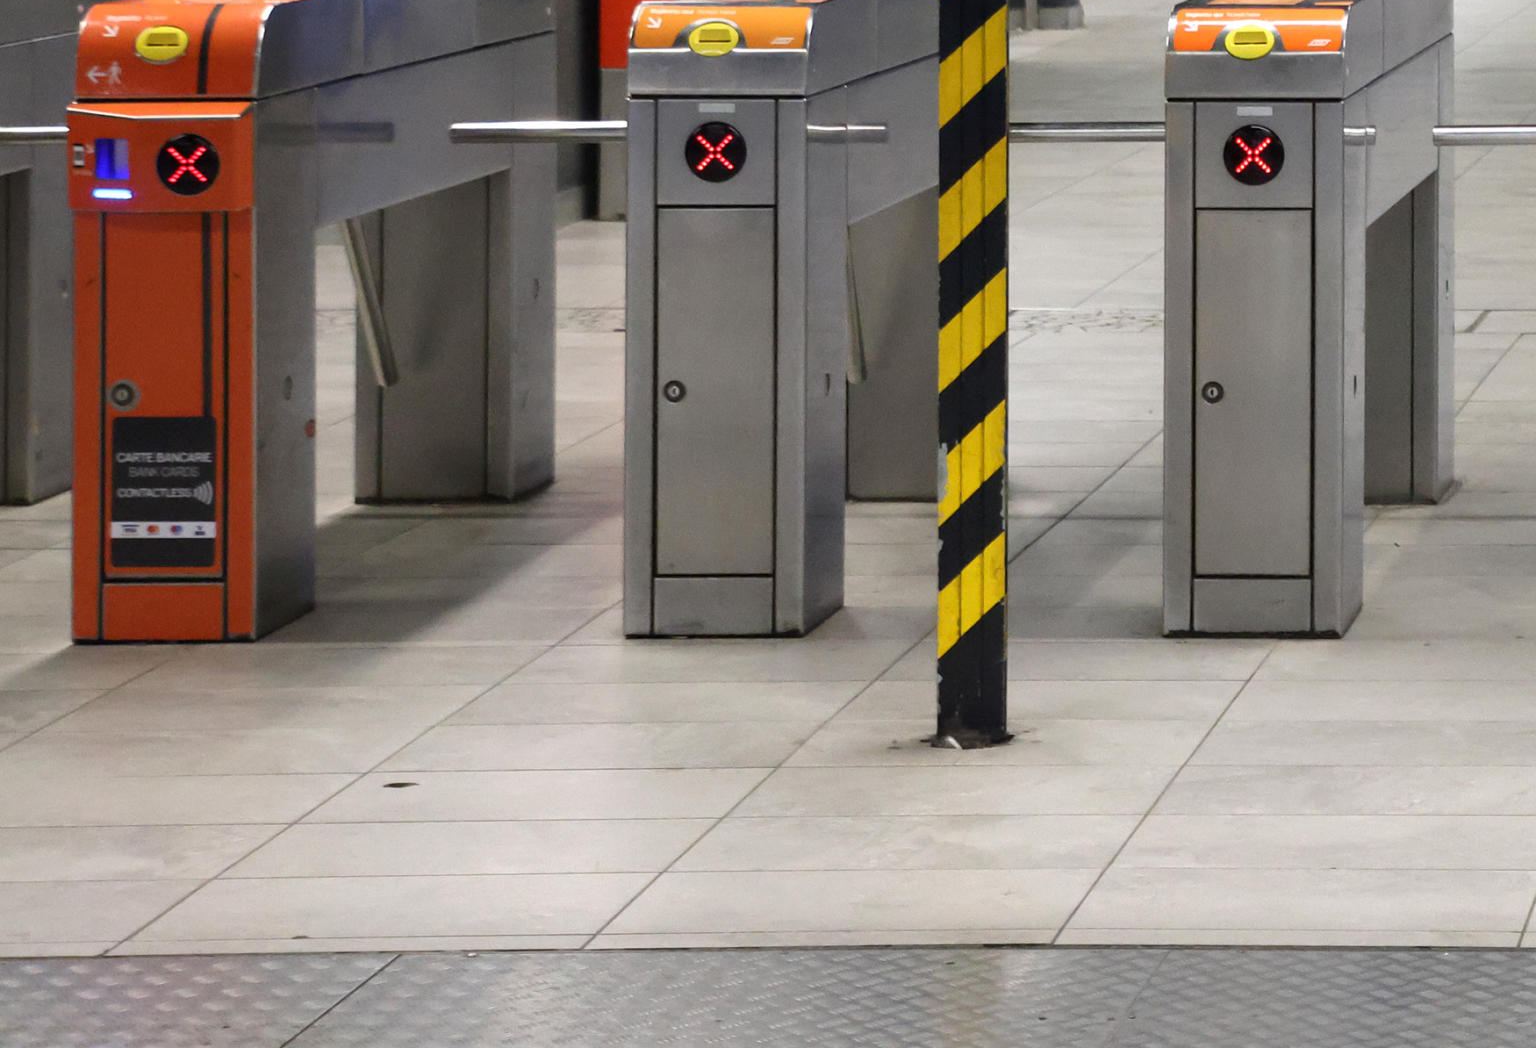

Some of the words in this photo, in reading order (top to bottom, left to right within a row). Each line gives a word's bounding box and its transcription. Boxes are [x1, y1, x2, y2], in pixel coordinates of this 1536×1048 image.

[116, 452, 155, 463] CARTE
[156, 452, 213, 463] BANCARIE
[117, 487, 193, 498] CONTACTLESS
